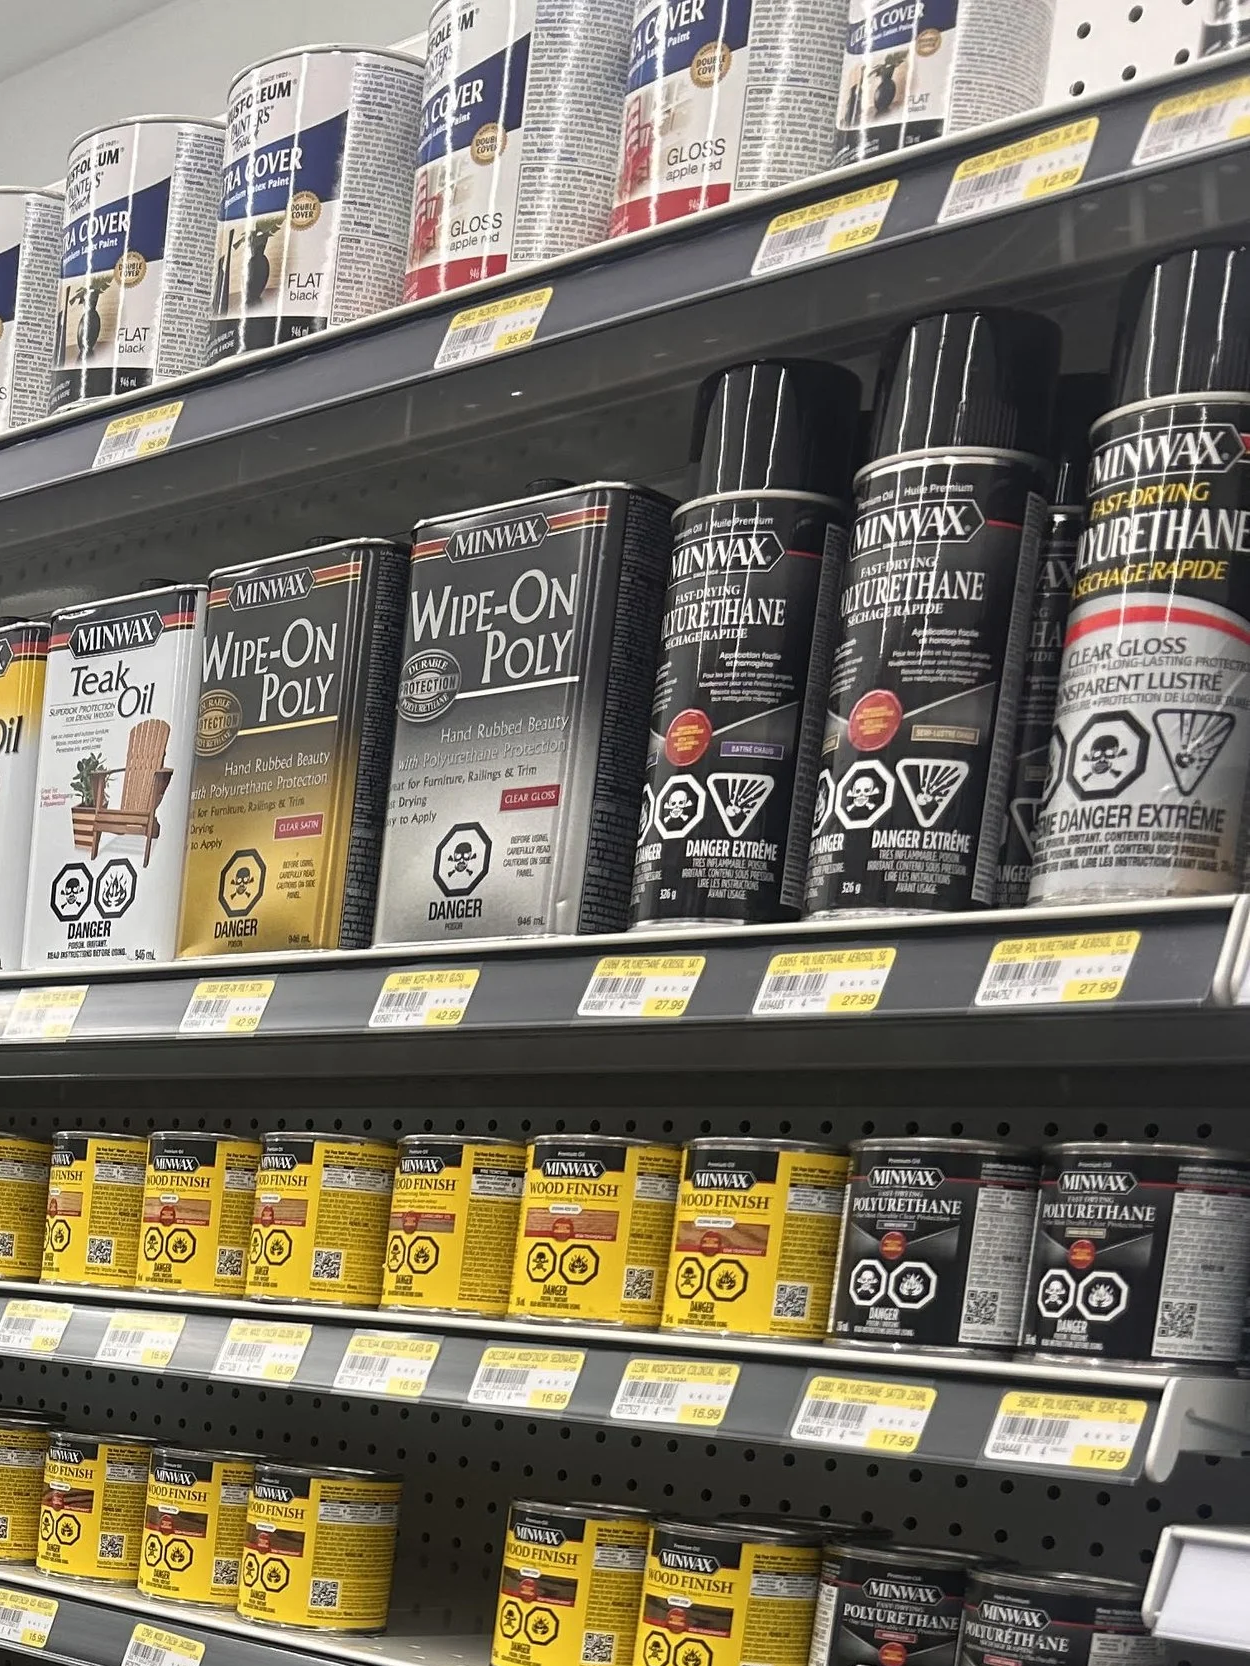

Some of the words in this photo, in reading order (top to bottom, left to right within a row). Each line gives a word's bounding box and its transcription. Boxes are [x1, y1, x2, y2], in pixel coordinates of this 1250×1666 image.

[666, 138, 725, 166] GLOSS
[666, 164, 698, 182] apple
[1042, 174, 1076, 190] 12.99
[844, 225, 877, 241] 12.99
[288, 273, 323, 288] FLAT
[290, 290, 318, 301] black
[118, 327, 149, 342] FLAT
[119, 343, 145, 353] black
[1095, 431, 1224, 486] MINWAX
[931, 482, 973, 494] Premium
[1090, 483, 1209, 520] FAST-DRYING
[455, 518, 540, 556] MINWAX
[854, 506, 969, 549] MINWAX
[860, 556, 936, 577] FAST-DRYING
[1150, 561, 1228, 583] RAPIDE
[236, 573, 307, 604] MINWAX
[904, 603, 943, 617] RAPIDE
[76, 618, 156, 653] MINWAX
[1069, 640, 1113, 666] CLEAR
[1117, 637, 1186, 657] GLOSS
[408, 659, 448, 676] DURABLE
[70, 661, 128, 696] Teak
[1151, 672, 1222, 695] LUSTRÉ
[117, 684, 155, 718] Oil
[441, 726, 471, 743] Hand
[478, 720, 522, 738] Rubbed
[528, 714, 570, 732] Beauty
[224, 760, 251, 776] Hand
[255, 755, 293, 772] Rubbed
[297, 752, 330, 770] Beauty
[398, 755, 418, 772] with
[423, 749, 497, 769] Polyurethane
[504, 738, 566, 758] Protection
[408, 776, 420, 788] for
[424, 772, 465, 788] Furniture,
[468, 770, 500, 781] Railings
[505, 768, 514, 777] &
[518, 766, 536, 776] Trim
[399, 796, 426, 809] Drying
[505, 793, 529, 803] CLEAR
[532, 791, 556, 800] GLOSS
[279, 822, 300, 832] CLEAR
[301, 821, 319, 831] SATIN
[400, 814, 409, 824] to
[411, 812, 437, 824] Apply
[1058, 807, 1131, 832] DANGER
[1137, 803, 1226, 833] EXTRÊME
[686, 839, 729, 857] DANGER
[732, 838, 776, 859] EXTRÊME
[872, 830, 919, 851] DANGER
[922, 828, 971, 850] EXTRÊME
[429, 899, 482, 921] DANGER
[68, 920, 111, 938] DANGER
[214, 919, 257, 938] DANGER
[1078, 982, 1117, 994] 27.99
[652, 999, 686, 1012] 27.99
[841, 993, 877, 1006] 27.99
[544, 1161, 602, 1178] MINWAX
[872, 1168, 938, 1188] MINWAX
[531, 1181, 568, 1197] WOOD
[572, 1181, 621, 1197] FINISH
[853, 1197, 962, 1215] POLYURETHANE
[1043, 1203, 1155, 1222] POLYURETHANE
[869, 1308, 899, 1321] DANGER
[881, 1432, 915, 1447] 17.99
[1089, 1449, 1126, 1464] 17.99
[681, 1576, 733, 1595] FINISH
